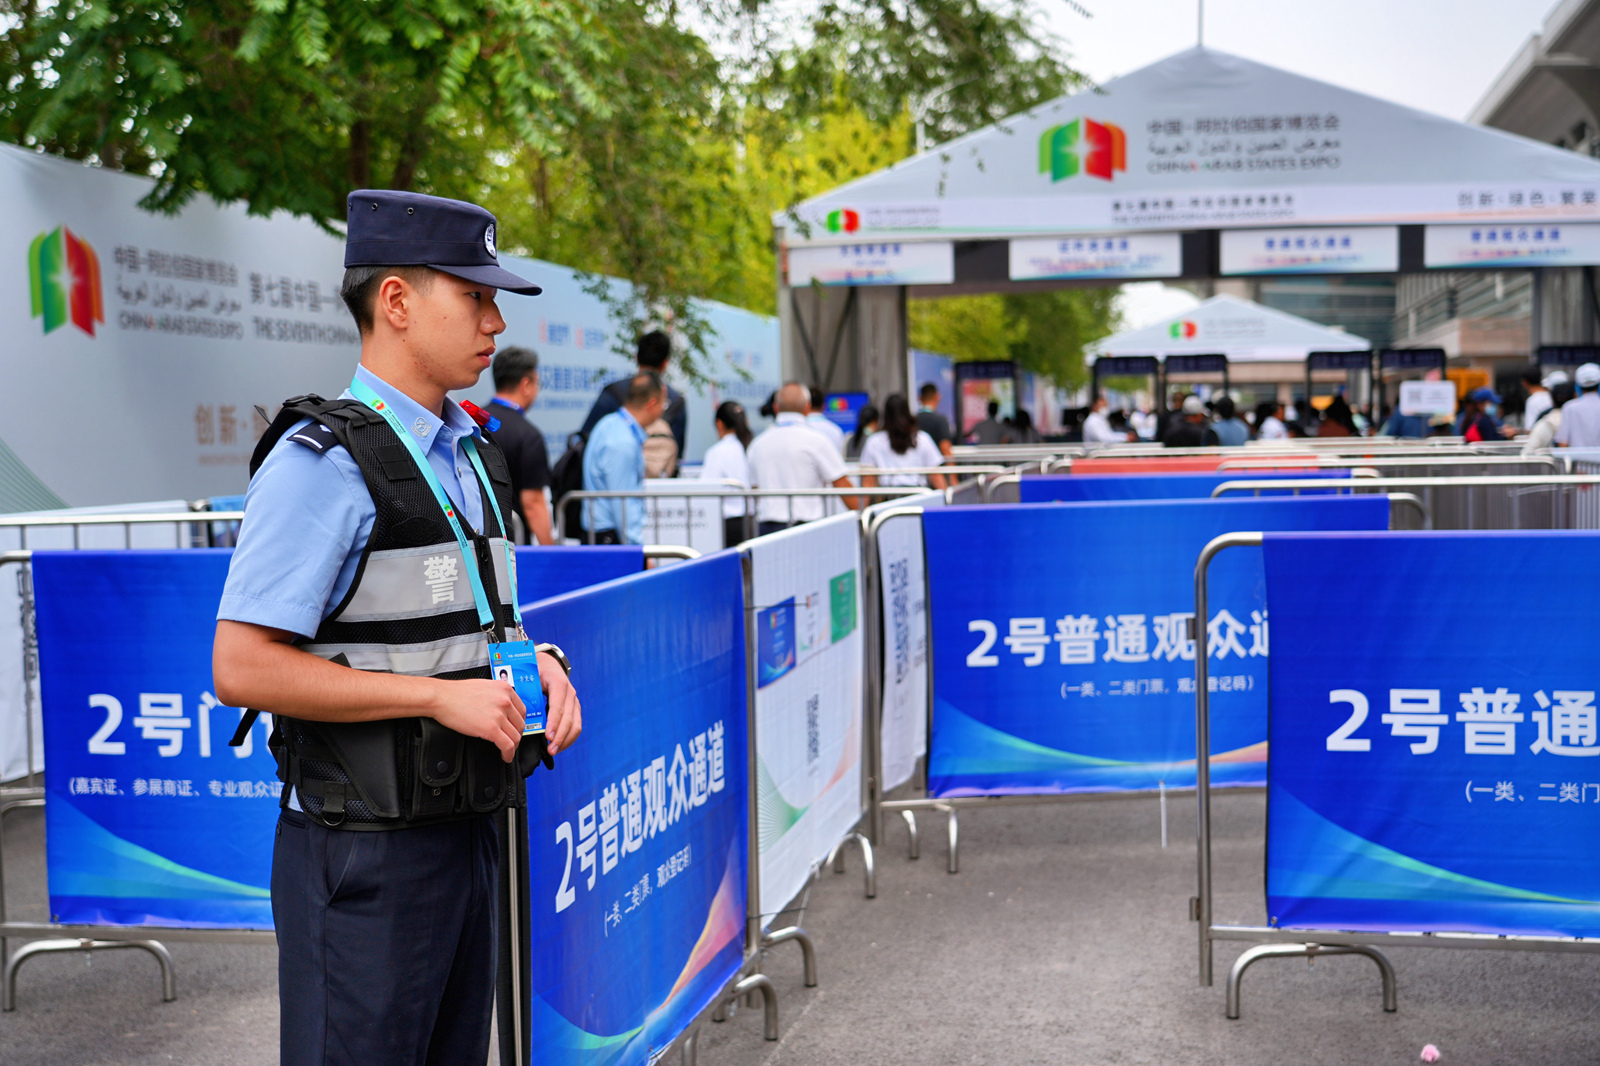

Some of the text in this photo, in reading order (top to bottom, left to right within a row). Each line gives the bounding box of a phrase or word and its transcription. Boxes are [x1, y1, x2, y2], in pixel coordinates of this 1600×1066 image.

[423, 555, 459, 604] 警
[87, 690, 273, 759] 2号门
[1325, 687, 1600, 757] 2号普通
[555, 719, 726, 914] 2号普通观众通道
